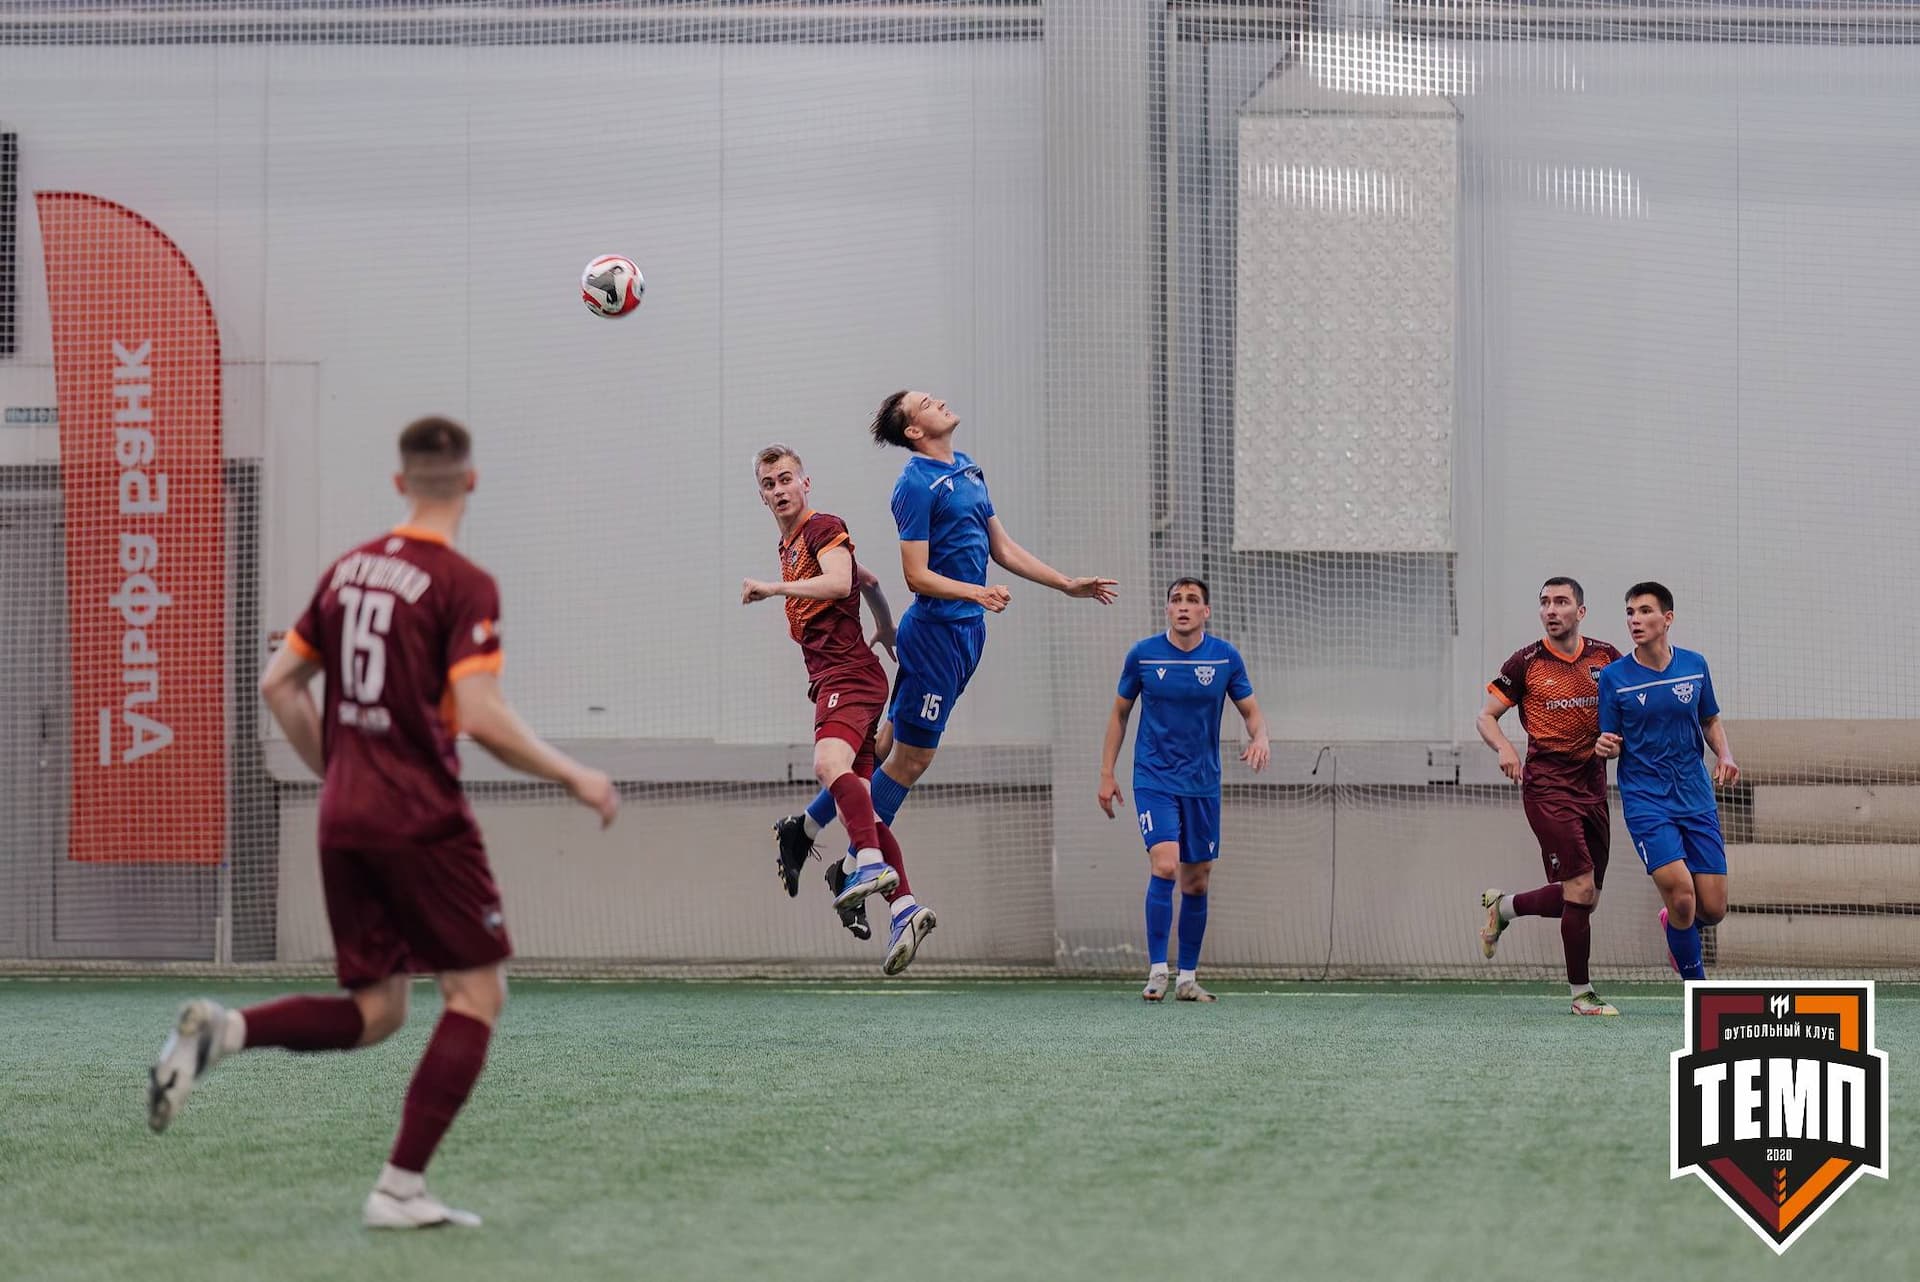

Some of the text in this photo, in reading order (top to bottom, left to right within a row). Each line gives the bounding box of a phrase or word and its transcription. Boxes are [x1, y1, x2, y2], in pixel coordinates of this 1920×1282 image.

[827, 692, 840, 708] 6
[920, 692, 943, 722] 15
[1139, 809, 1153, 835] 21
